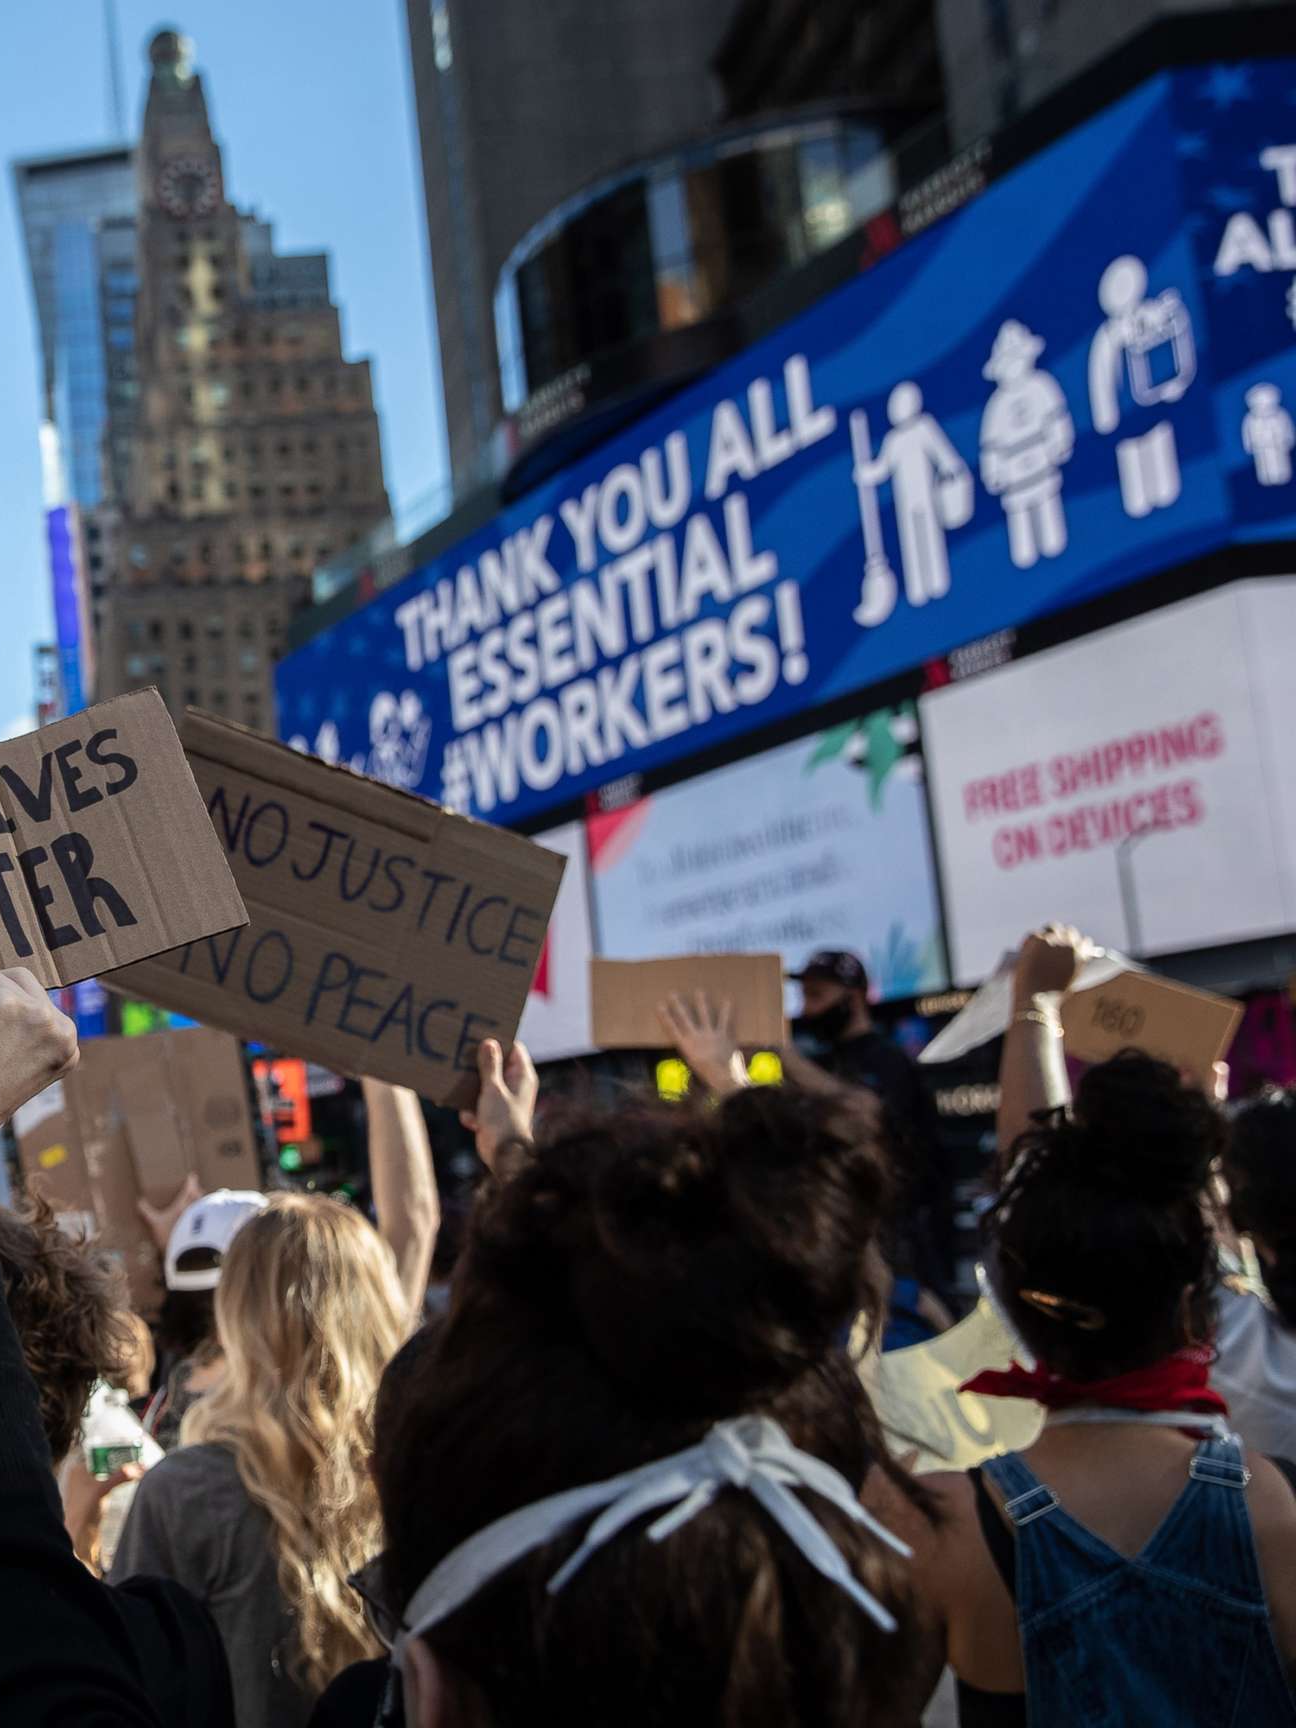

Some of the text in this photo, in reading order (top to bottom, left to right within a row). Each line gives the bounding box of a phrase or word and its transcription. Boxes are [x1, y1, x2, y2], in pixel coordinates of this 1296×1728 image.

[395, 515, 562, 671] THANK
[560, 430, 692, 573] YOU
[705, 353, 837, 500] ALL
[441, 579, 809, 815] #WORKERS!
[447, 492, 778, 732] ESSENTIAL
[963, 709, 1227, 824] FREE SHIPPING
[992, 777, 1205, 872] ON DEVICES
[206, 786, 289, 867] NO
[290, 820, 544, 968] JUSTICE
[178, 928, 501, 1072] NO PEACE
